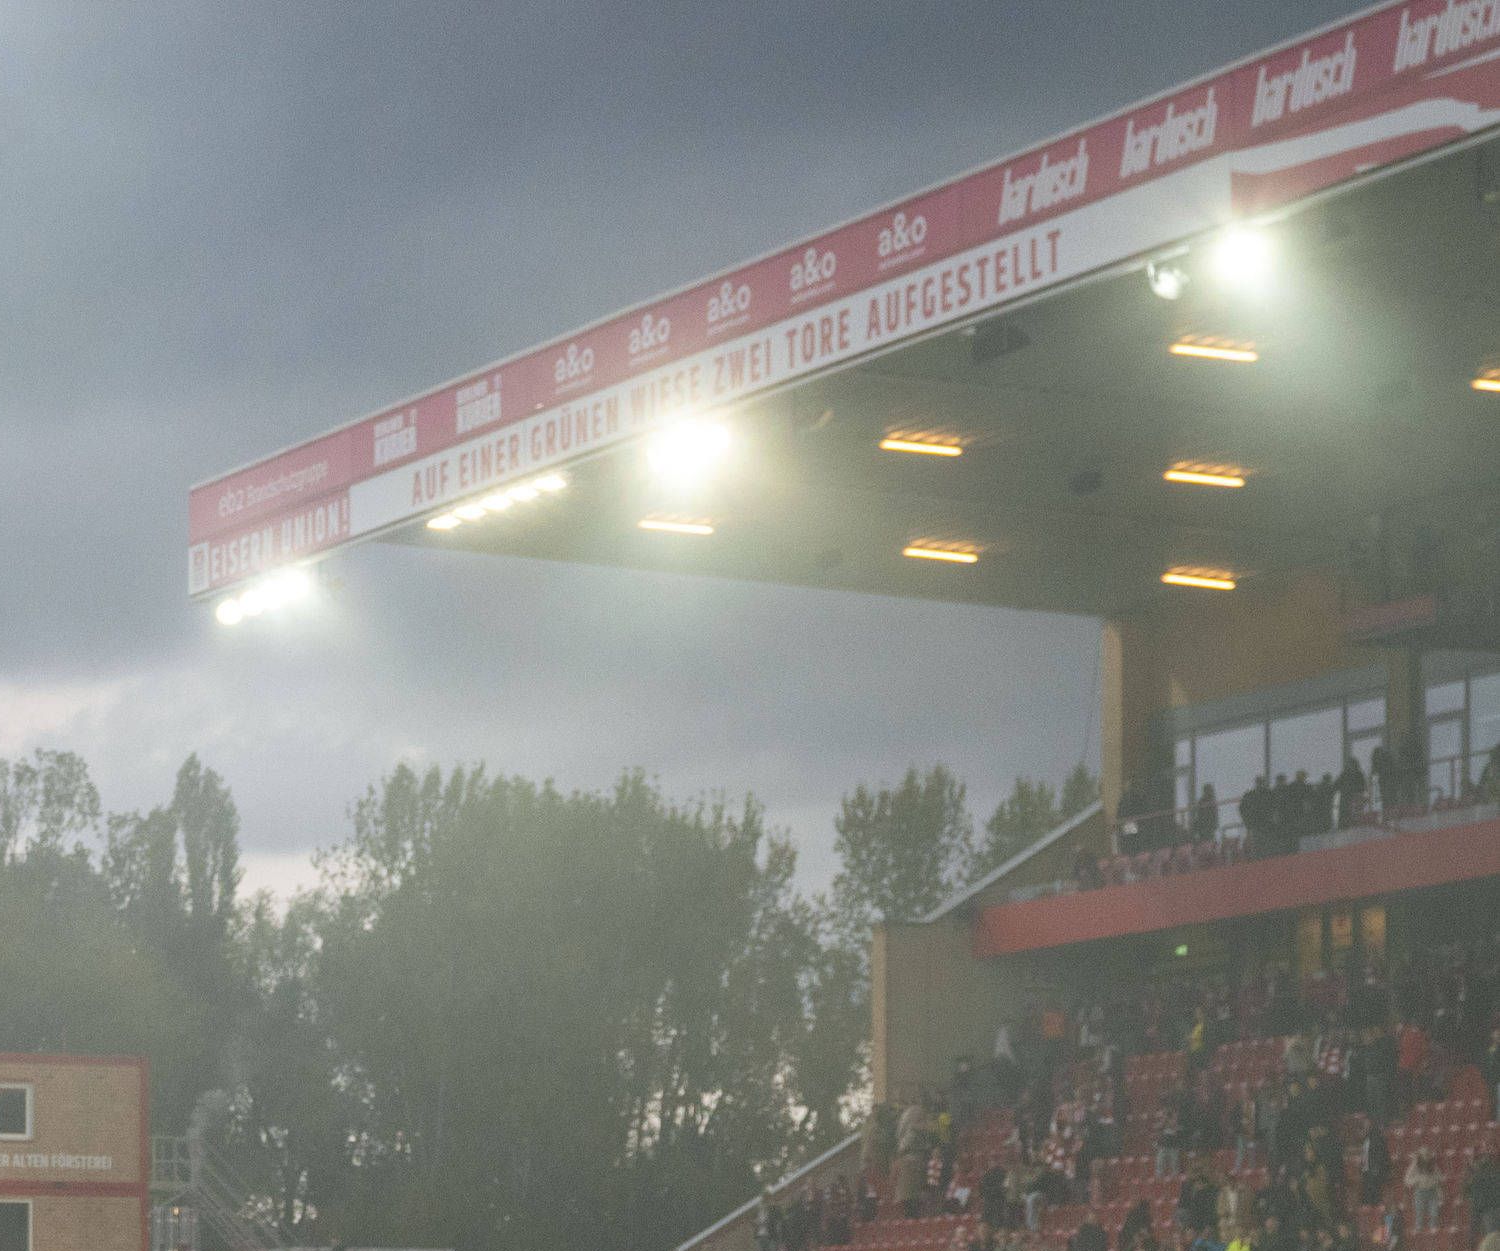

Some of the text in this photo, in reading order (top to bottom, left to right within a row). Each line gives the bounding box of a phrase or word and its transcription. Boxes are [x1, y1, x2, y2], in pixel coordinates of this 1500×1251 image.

[878, 213, 928, 257] a&o
[790, 248, 836, 291] a&o
[707, 281, 751, 324] a&o
[628, 314, 671, 354] a&o
[412, 455, 449, 506] AUF
[459, 438, 520, 489] EINER
[531, 395, 619, 461] GRÜNEN
[713, 338, 773, 396] ZWEI
[786, 309, 851, 370] TORE
[866, 231, 1062, 341] AUFGESTELLT
[555, 344, 595, 382] a&o
[212, 497, 350, 580] EISERN UNION!
